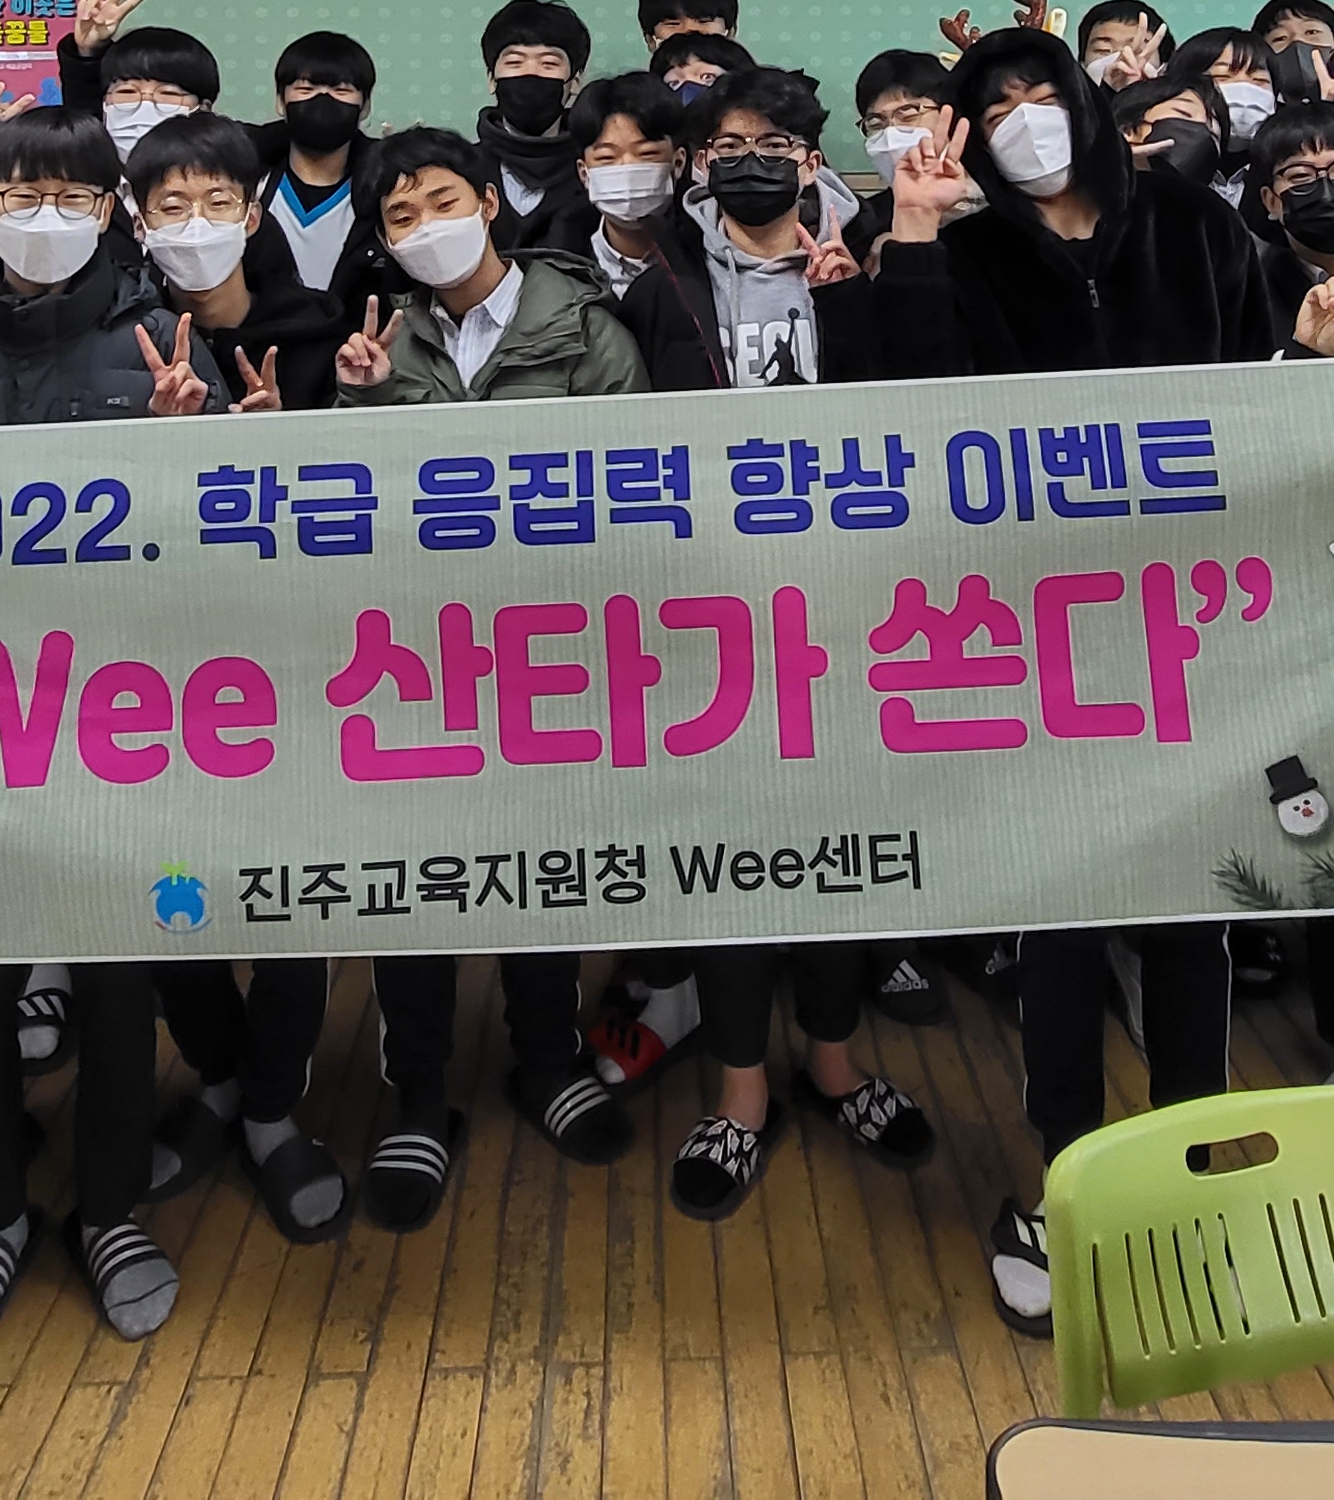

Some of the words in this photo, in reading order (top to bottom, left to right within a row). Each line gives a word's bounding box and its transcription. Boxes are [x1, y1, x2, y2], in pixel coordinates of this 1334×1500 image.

[197, 462, 380, 560] 학급
[412, 445, 693, 552] 응집력
[727, 433, 916, 537] 향상
[945, 418, 1227, 526] 이벤트
[324, 585, 830, 783] 산타가
[237, 842, 649, 925] 진주교육지원청
[668, 829, 924, 896] Wee센터
[881, 978, 929, 992] adidas
